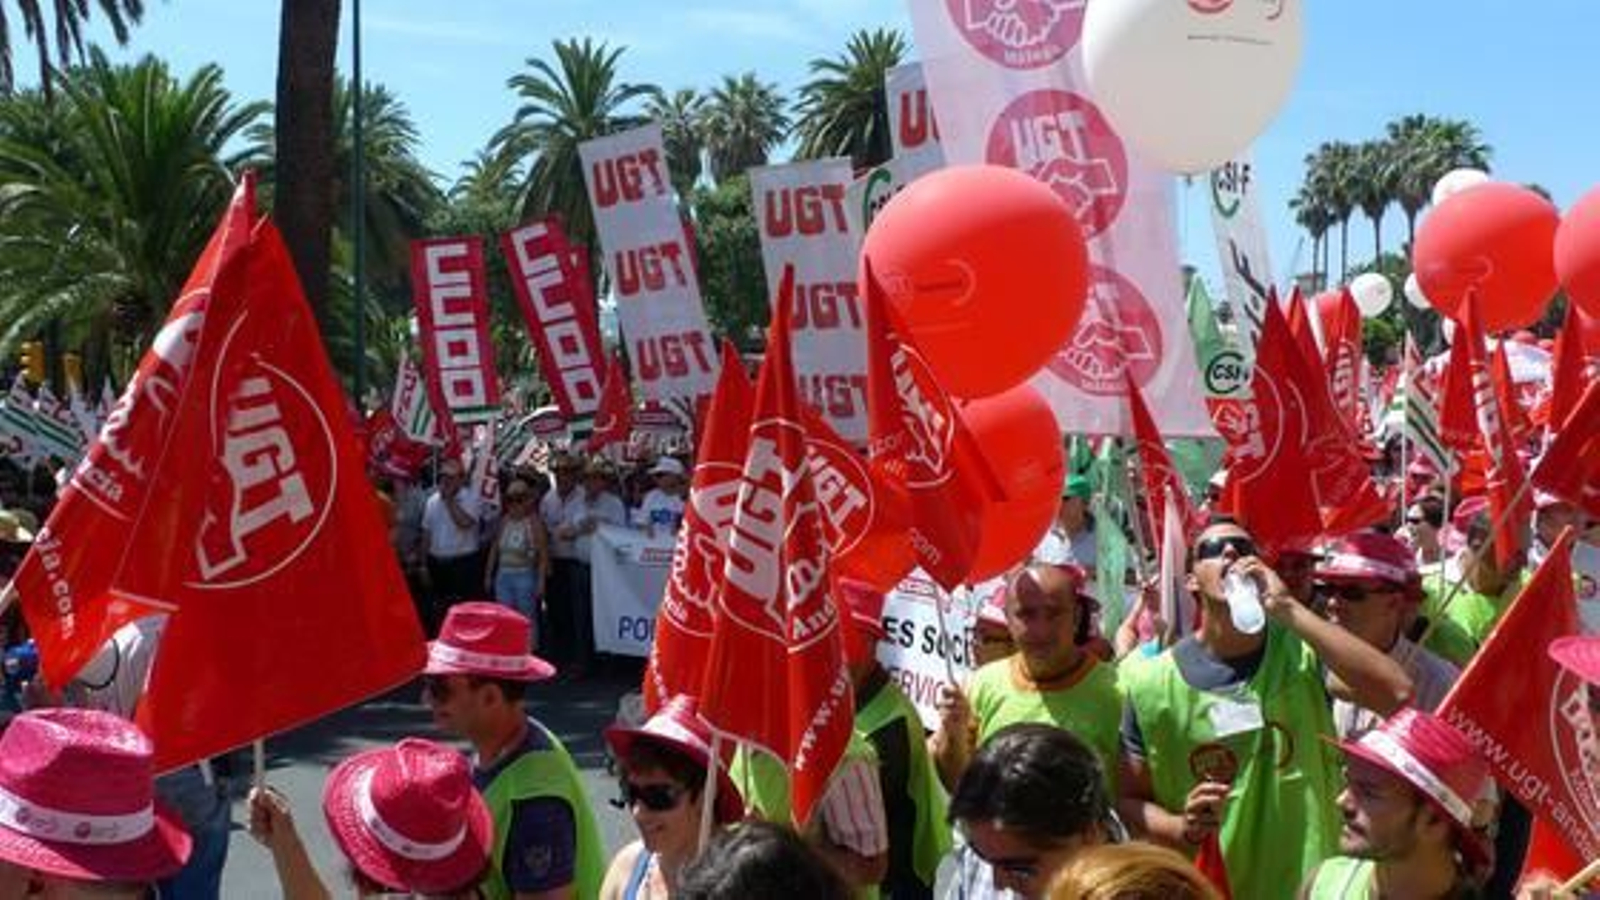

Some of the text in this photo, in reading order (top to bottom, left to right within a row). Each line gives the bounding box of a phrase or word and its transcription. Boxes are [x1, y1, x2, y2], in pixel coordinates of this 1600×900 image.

[1010, 108, 1090, 166] UGT
[592, 147, 666, 209] UGT
[764, 182, 848, 239] UGT
[615, 240, 688, 297] UGT
[425, 242, 487, 408] CCOO
[511, 221, 602, 415] CCOO
[635, 329, 712, 382] UGT
[221, 375, 315, 540] UGT
